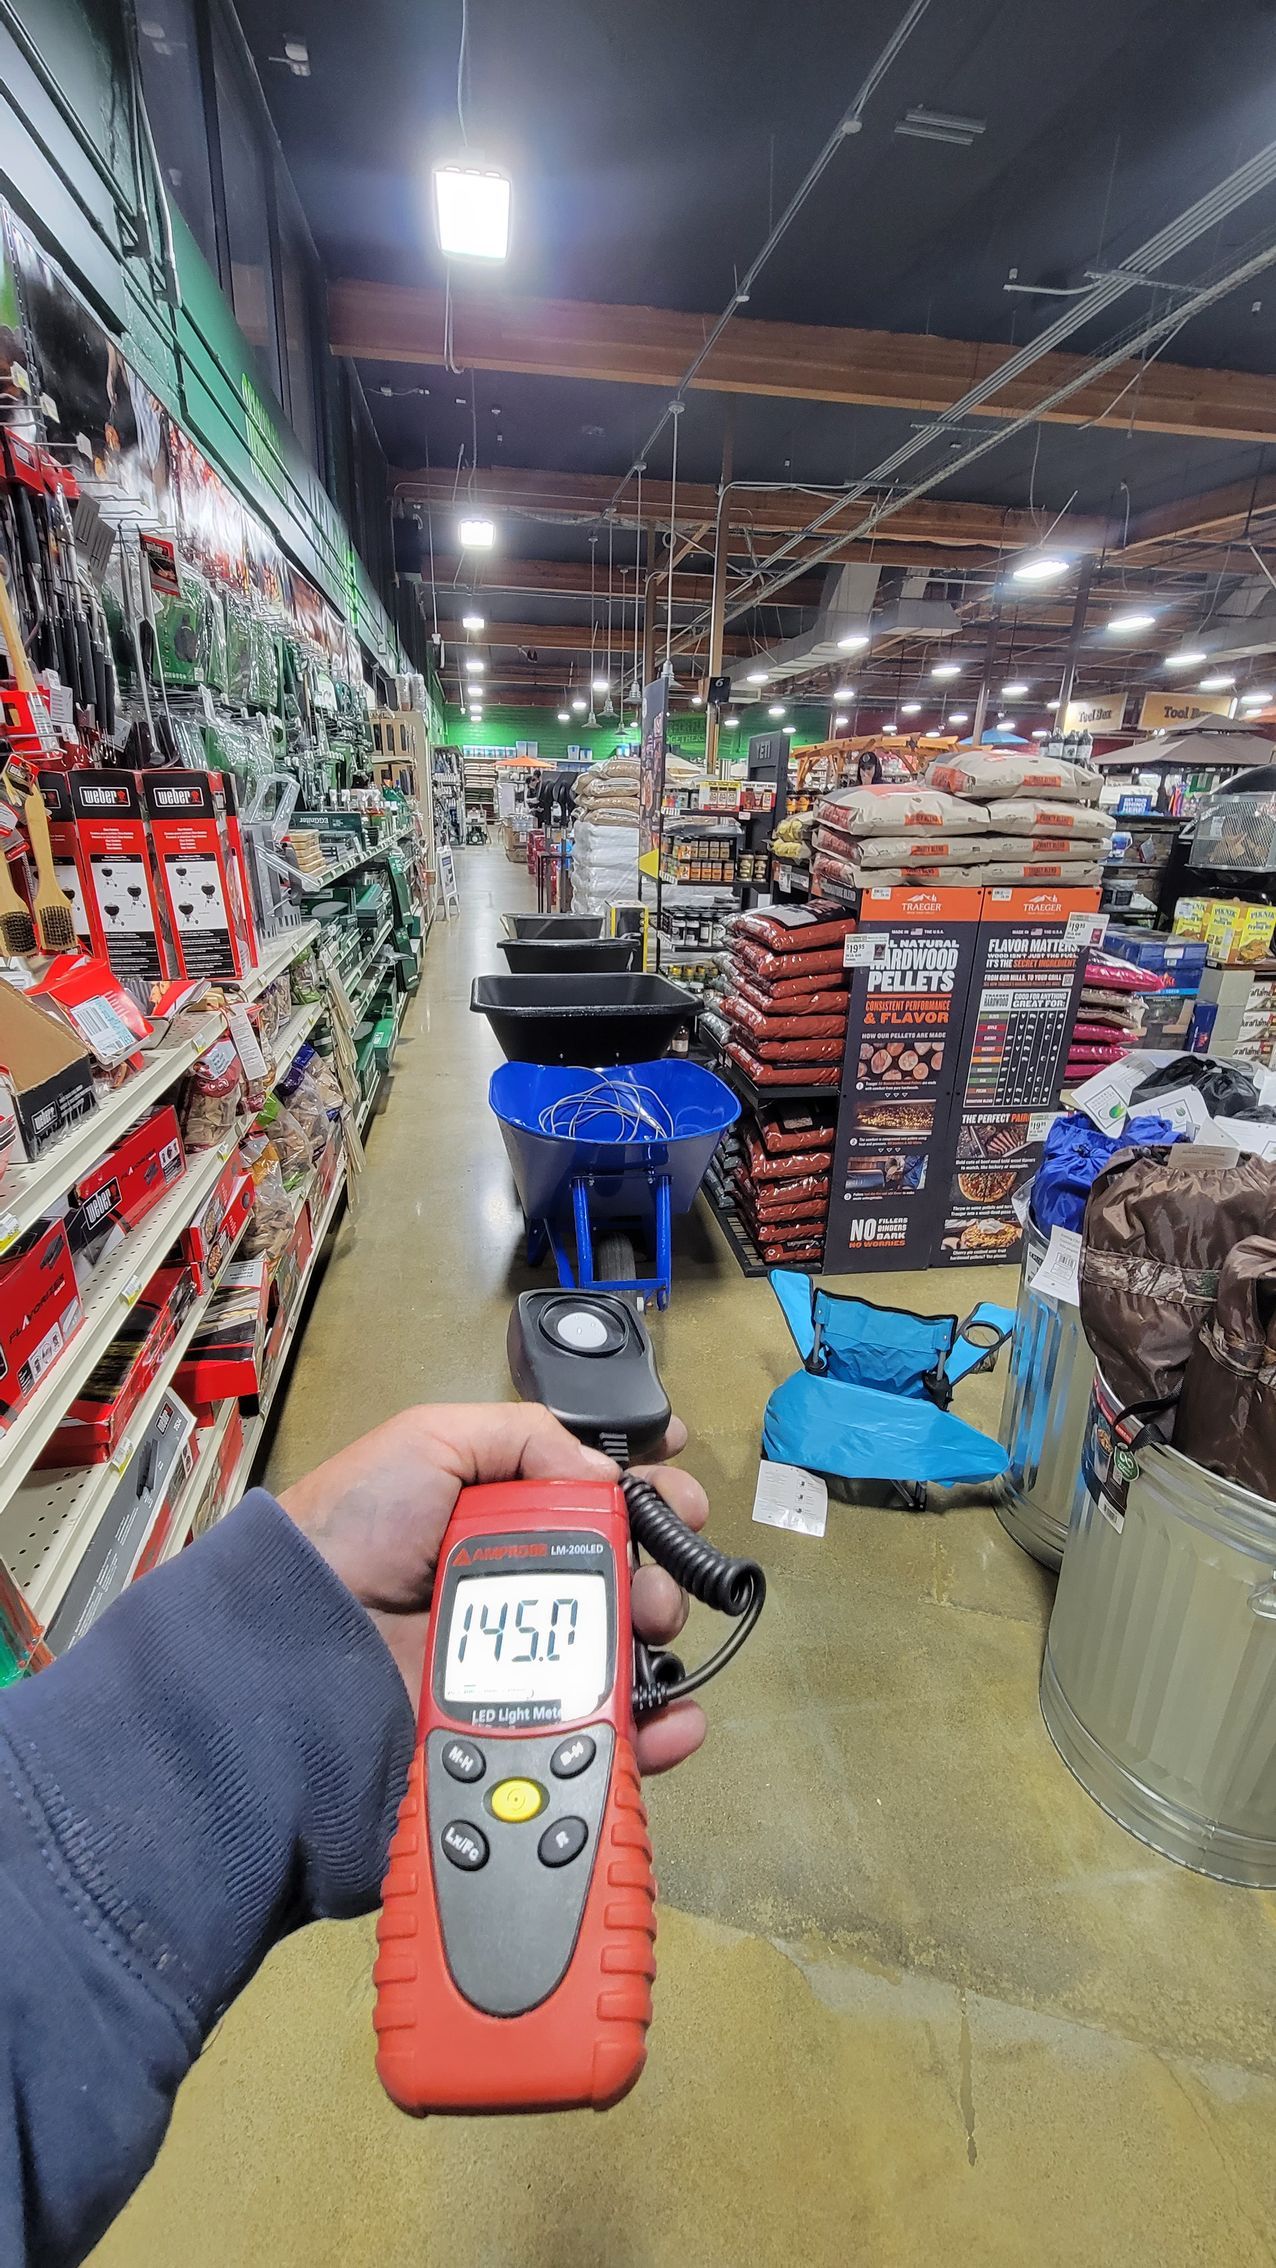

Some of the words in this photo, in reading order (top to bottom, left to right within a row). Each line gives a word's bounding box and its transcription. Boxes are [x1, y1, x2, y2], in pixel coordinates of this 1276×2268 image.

[716, 678, 724, 687] 6
[1080, 710, 1096, 722] Tool
[1098, 709, 1112, 720] Box
[1164, 706, 1188, 718] Tool
[84, 788, 117, 803] weber
[158, 788, 191, 803] weber
[902, 903, 942, 911] TRAEGER
[900, 939, 960, 948] NATURAL
[988, 939, 1028, 952] FLAVOR
[869, 949, 959, 970] RDWOOD
[986, 959, 999, 968] IT'S
[1000, 959, 1013, 968] THE
[1013, 959, 1039, 968] SECRET
[867, 970, 955, 992] PELLETS
[984, 974, 999, 982] FROM
[865, 1001, 904, 1011] CONSISTENT
[905, 1000, 950, 1011] PERFORMANCE
[1045, 999, 1066, 1008] FOR:
[863, 1013, 876, 1024] &
[880, 1012, 949, 1023] FLAVOR
[962, 1114, 976, 1124] THE
[977, 1114, 1010, 1123] PERFECT
[86, 1188, 112, 1224] weber
[850, 1218, 877, 1241] NO
[877, 1224, 907, 1232] BINDERS
[876, 1232, 906, 1240] BARK
[848, 1241, 862, 1249] NO
[863, 1240, 906, 1248] WORRIES
[551, 1544, 604, 1556] LM-200LED
[458, 1598, 578, 1663] 145.0
[472, 1709, 496, 1723] LED
[498, 1706, 530, 1724] Light
